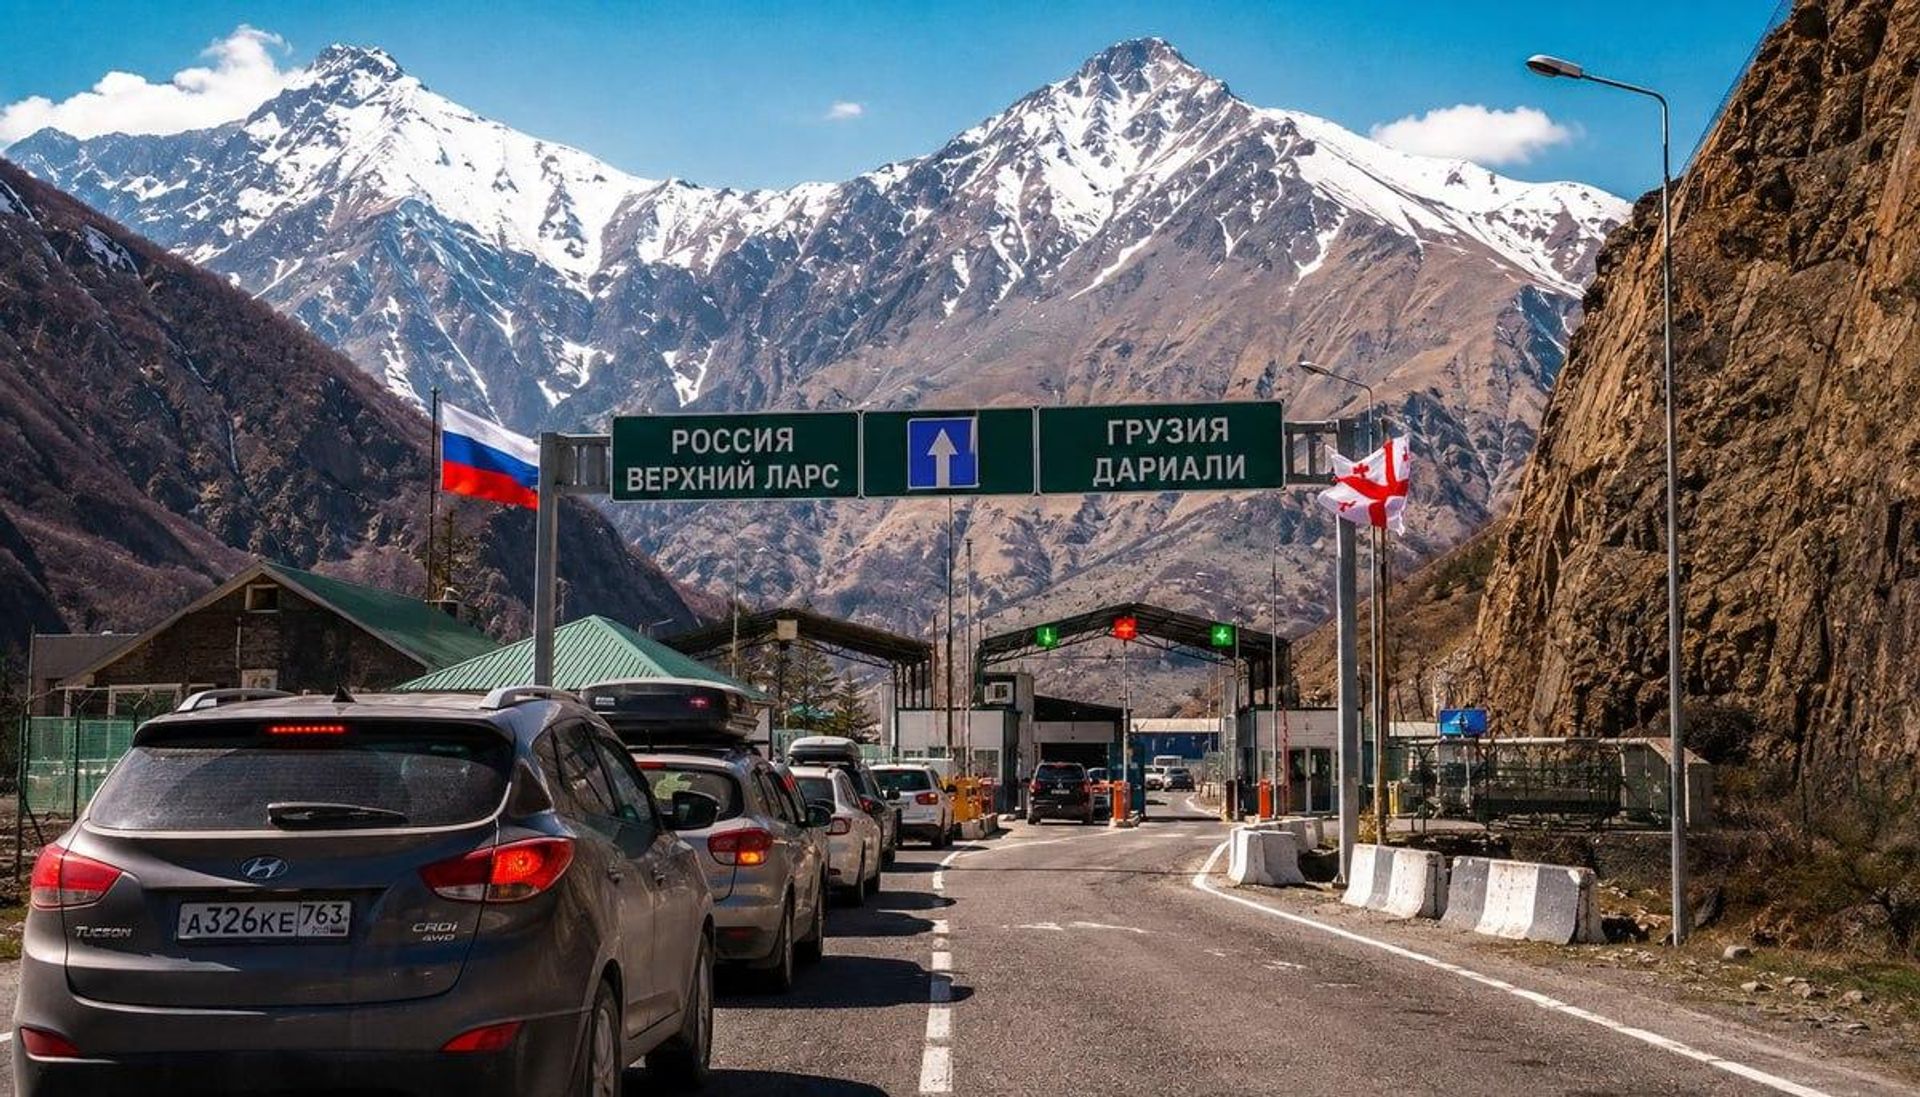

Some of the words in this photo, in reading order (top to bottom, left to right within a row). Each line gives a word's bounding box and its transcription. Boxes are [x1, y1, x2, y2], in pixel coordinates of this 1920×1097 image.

[671, 427, 795, 454] РОССИЯ
[1107, 416, 1229, 446] ГРУЗИЯ
[626, 459, 755, 492] ВЕРХНИЙ
[764, 463, 840, 489] ЛАРС
[1092, 454, 1246, 488] ДАРИАЛИ
[302, 904, 344, 926] 763
